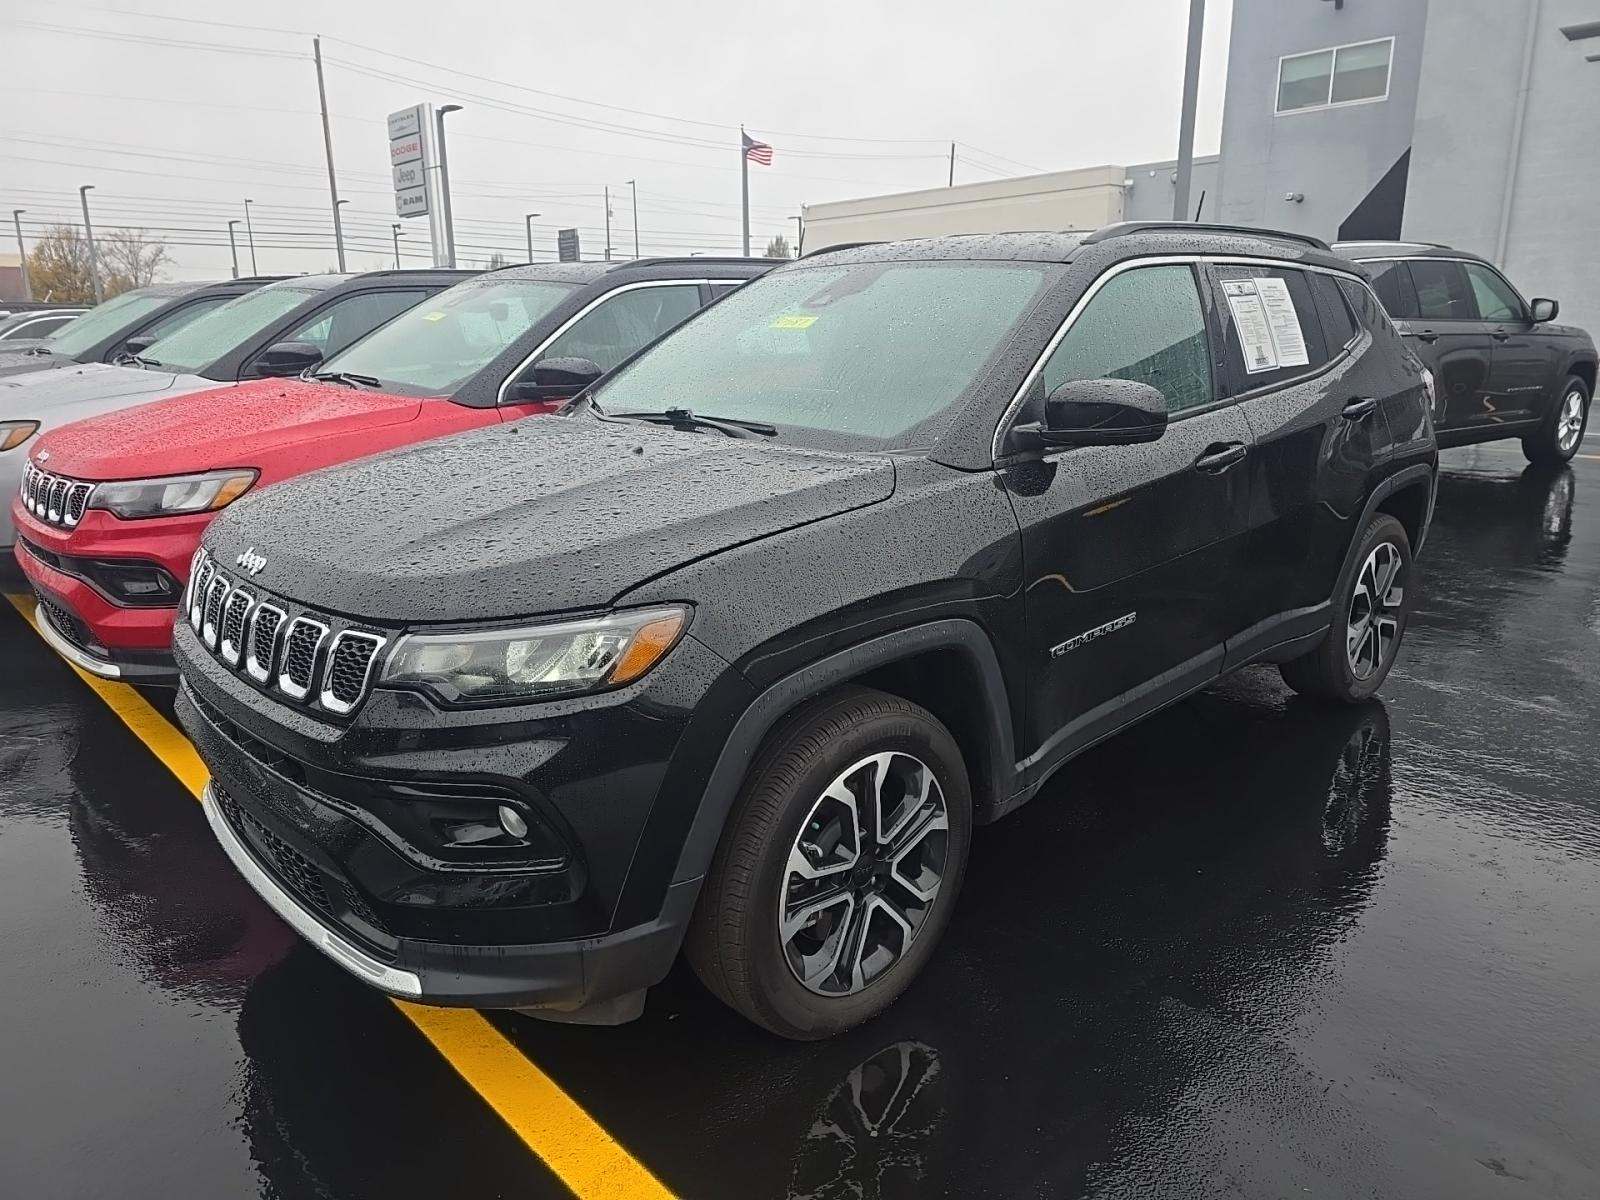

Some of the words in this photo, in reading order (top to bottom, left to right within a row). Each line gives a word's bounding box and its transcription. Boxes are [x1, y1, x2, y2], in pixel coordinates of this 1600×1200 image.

[391, 143, 418, 157] DODGE
[398, 168, 416, 185] Jeep
[403, 194, 423, 206] RAM
[236, 546, 268, 577] Jeep
[1048, 611, 1137, 659] COMPASS
